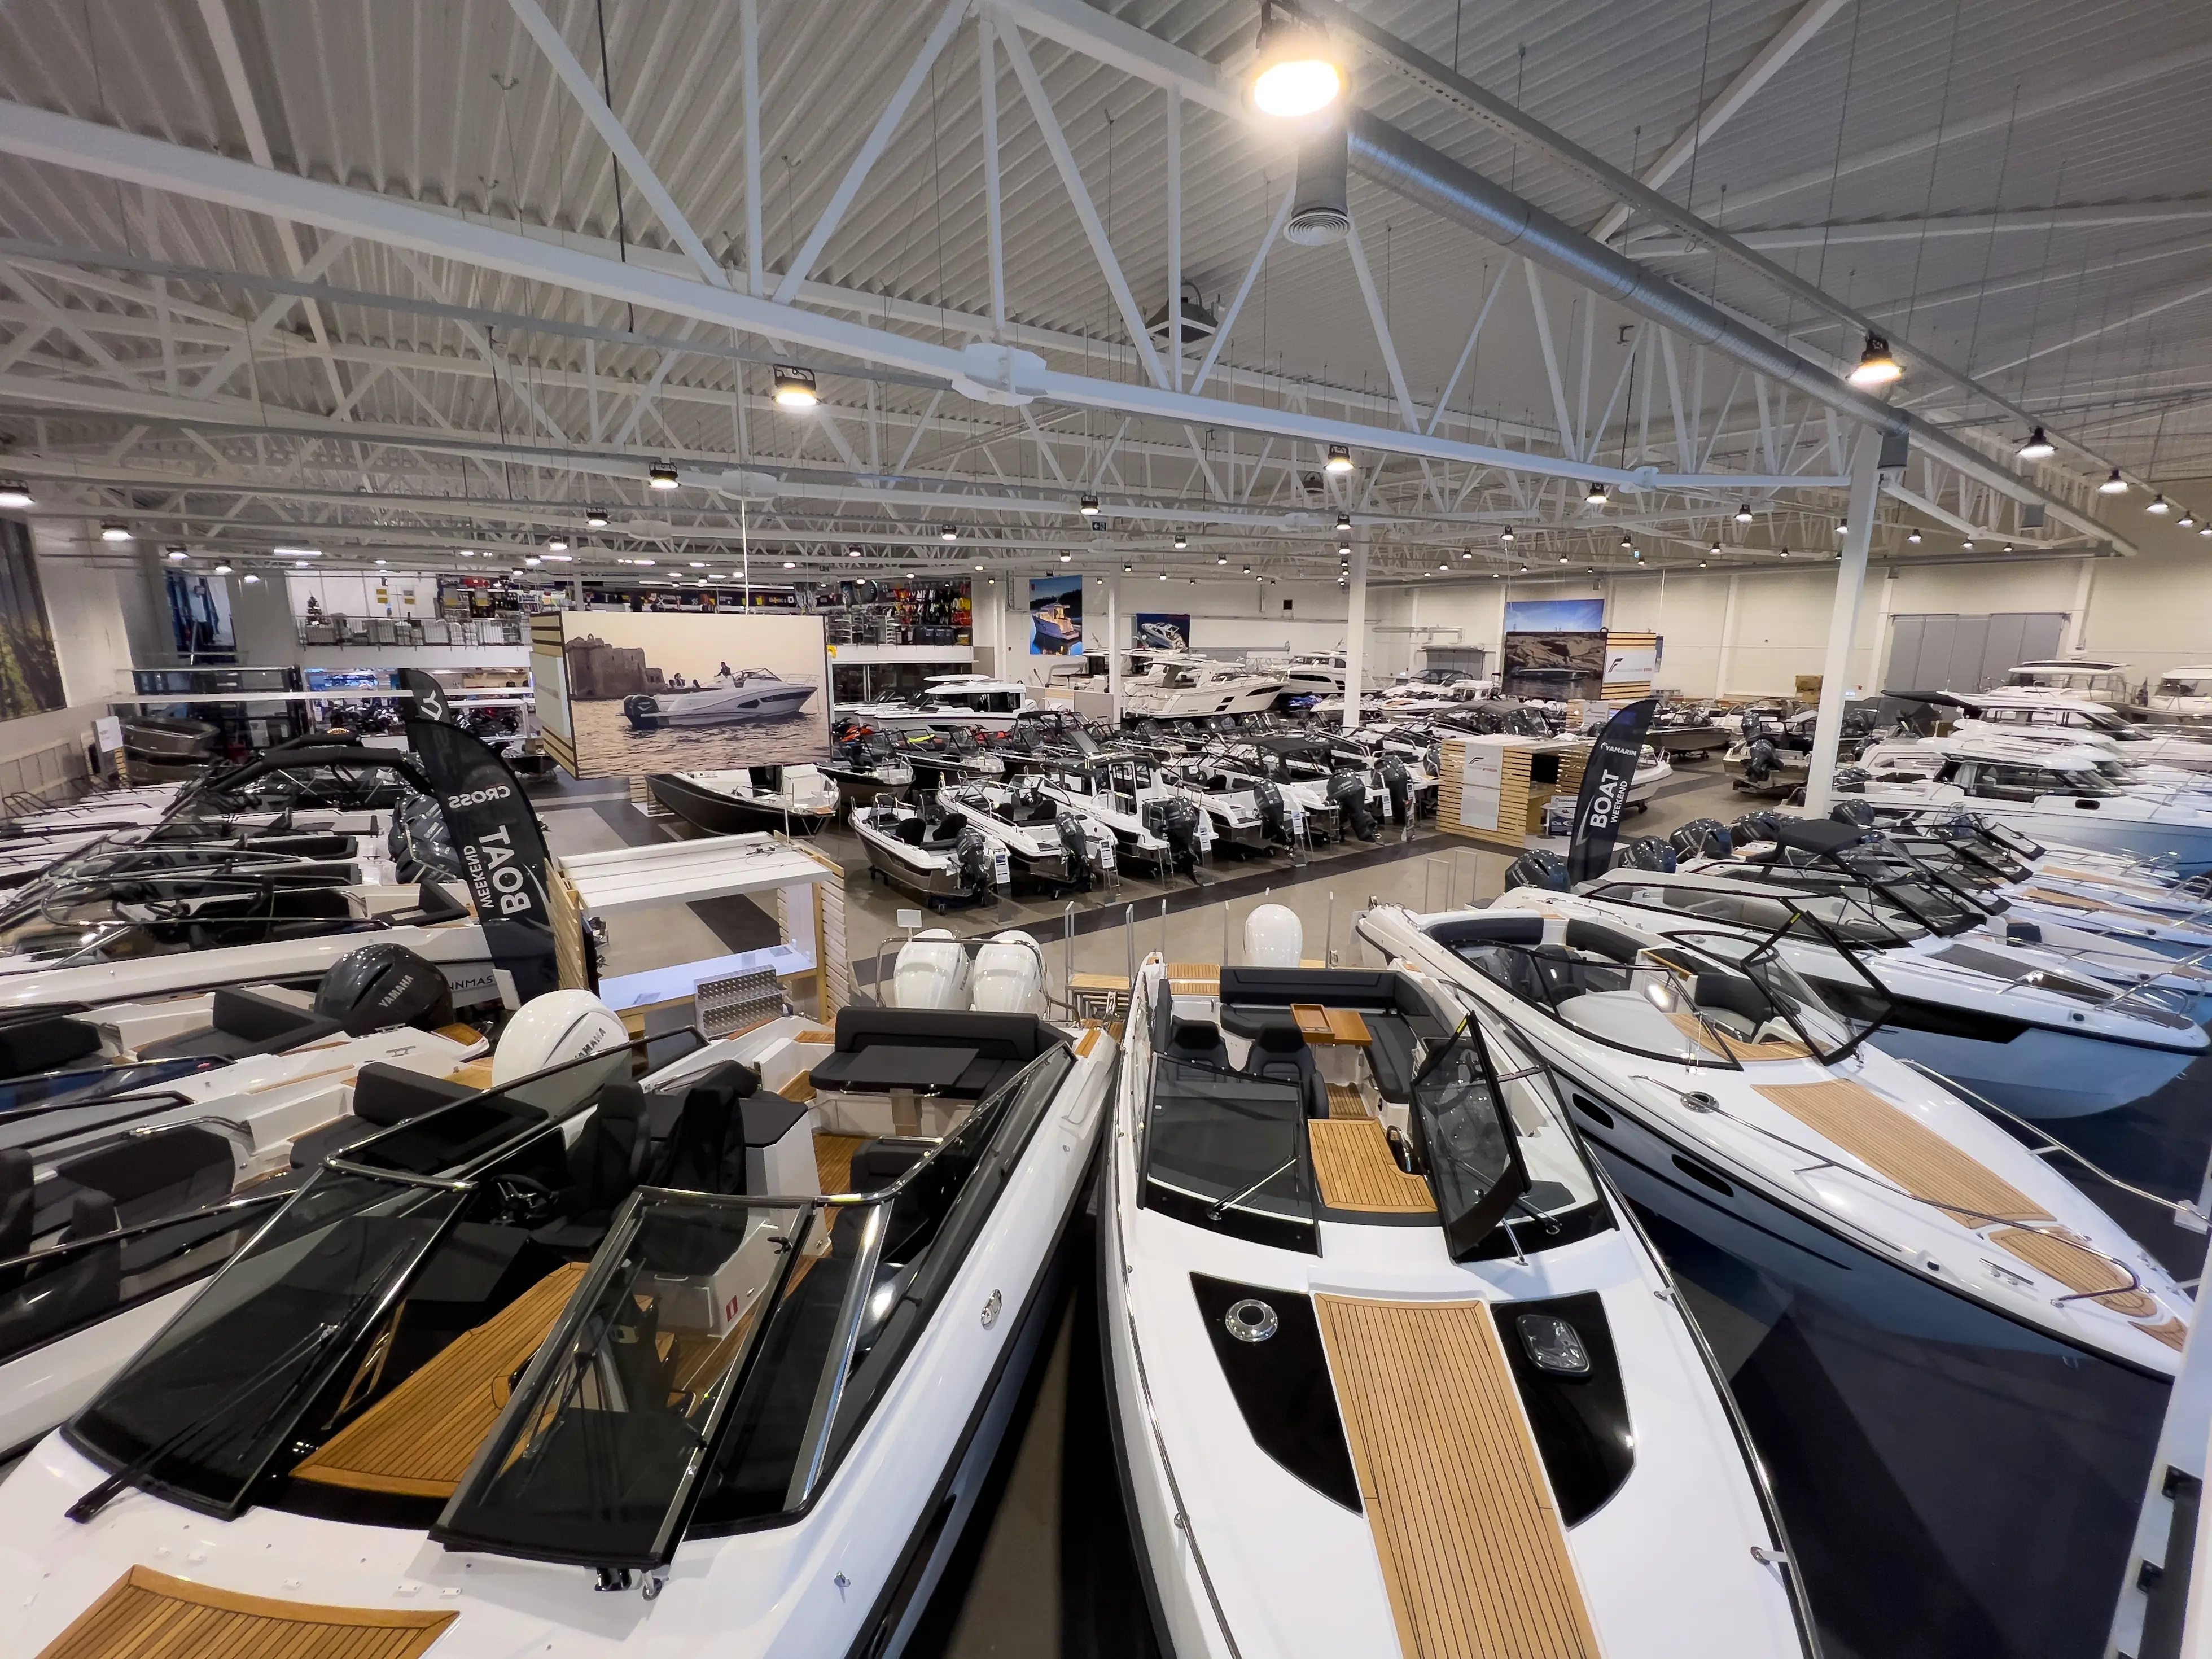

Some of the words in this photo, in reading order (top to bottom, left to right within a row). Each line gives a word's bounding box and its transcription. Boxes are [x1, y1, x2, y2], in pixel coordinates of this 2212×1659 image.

[1605, 745, 1636, 756] YAMARIN
[1589, 769, 1619, 828] BOAT
[1610, 781, 1627, 823] WEEKEND
[378, 974, 414, 1008] YAMAHA
[575, 1027, 606, 1058] AMAHA
